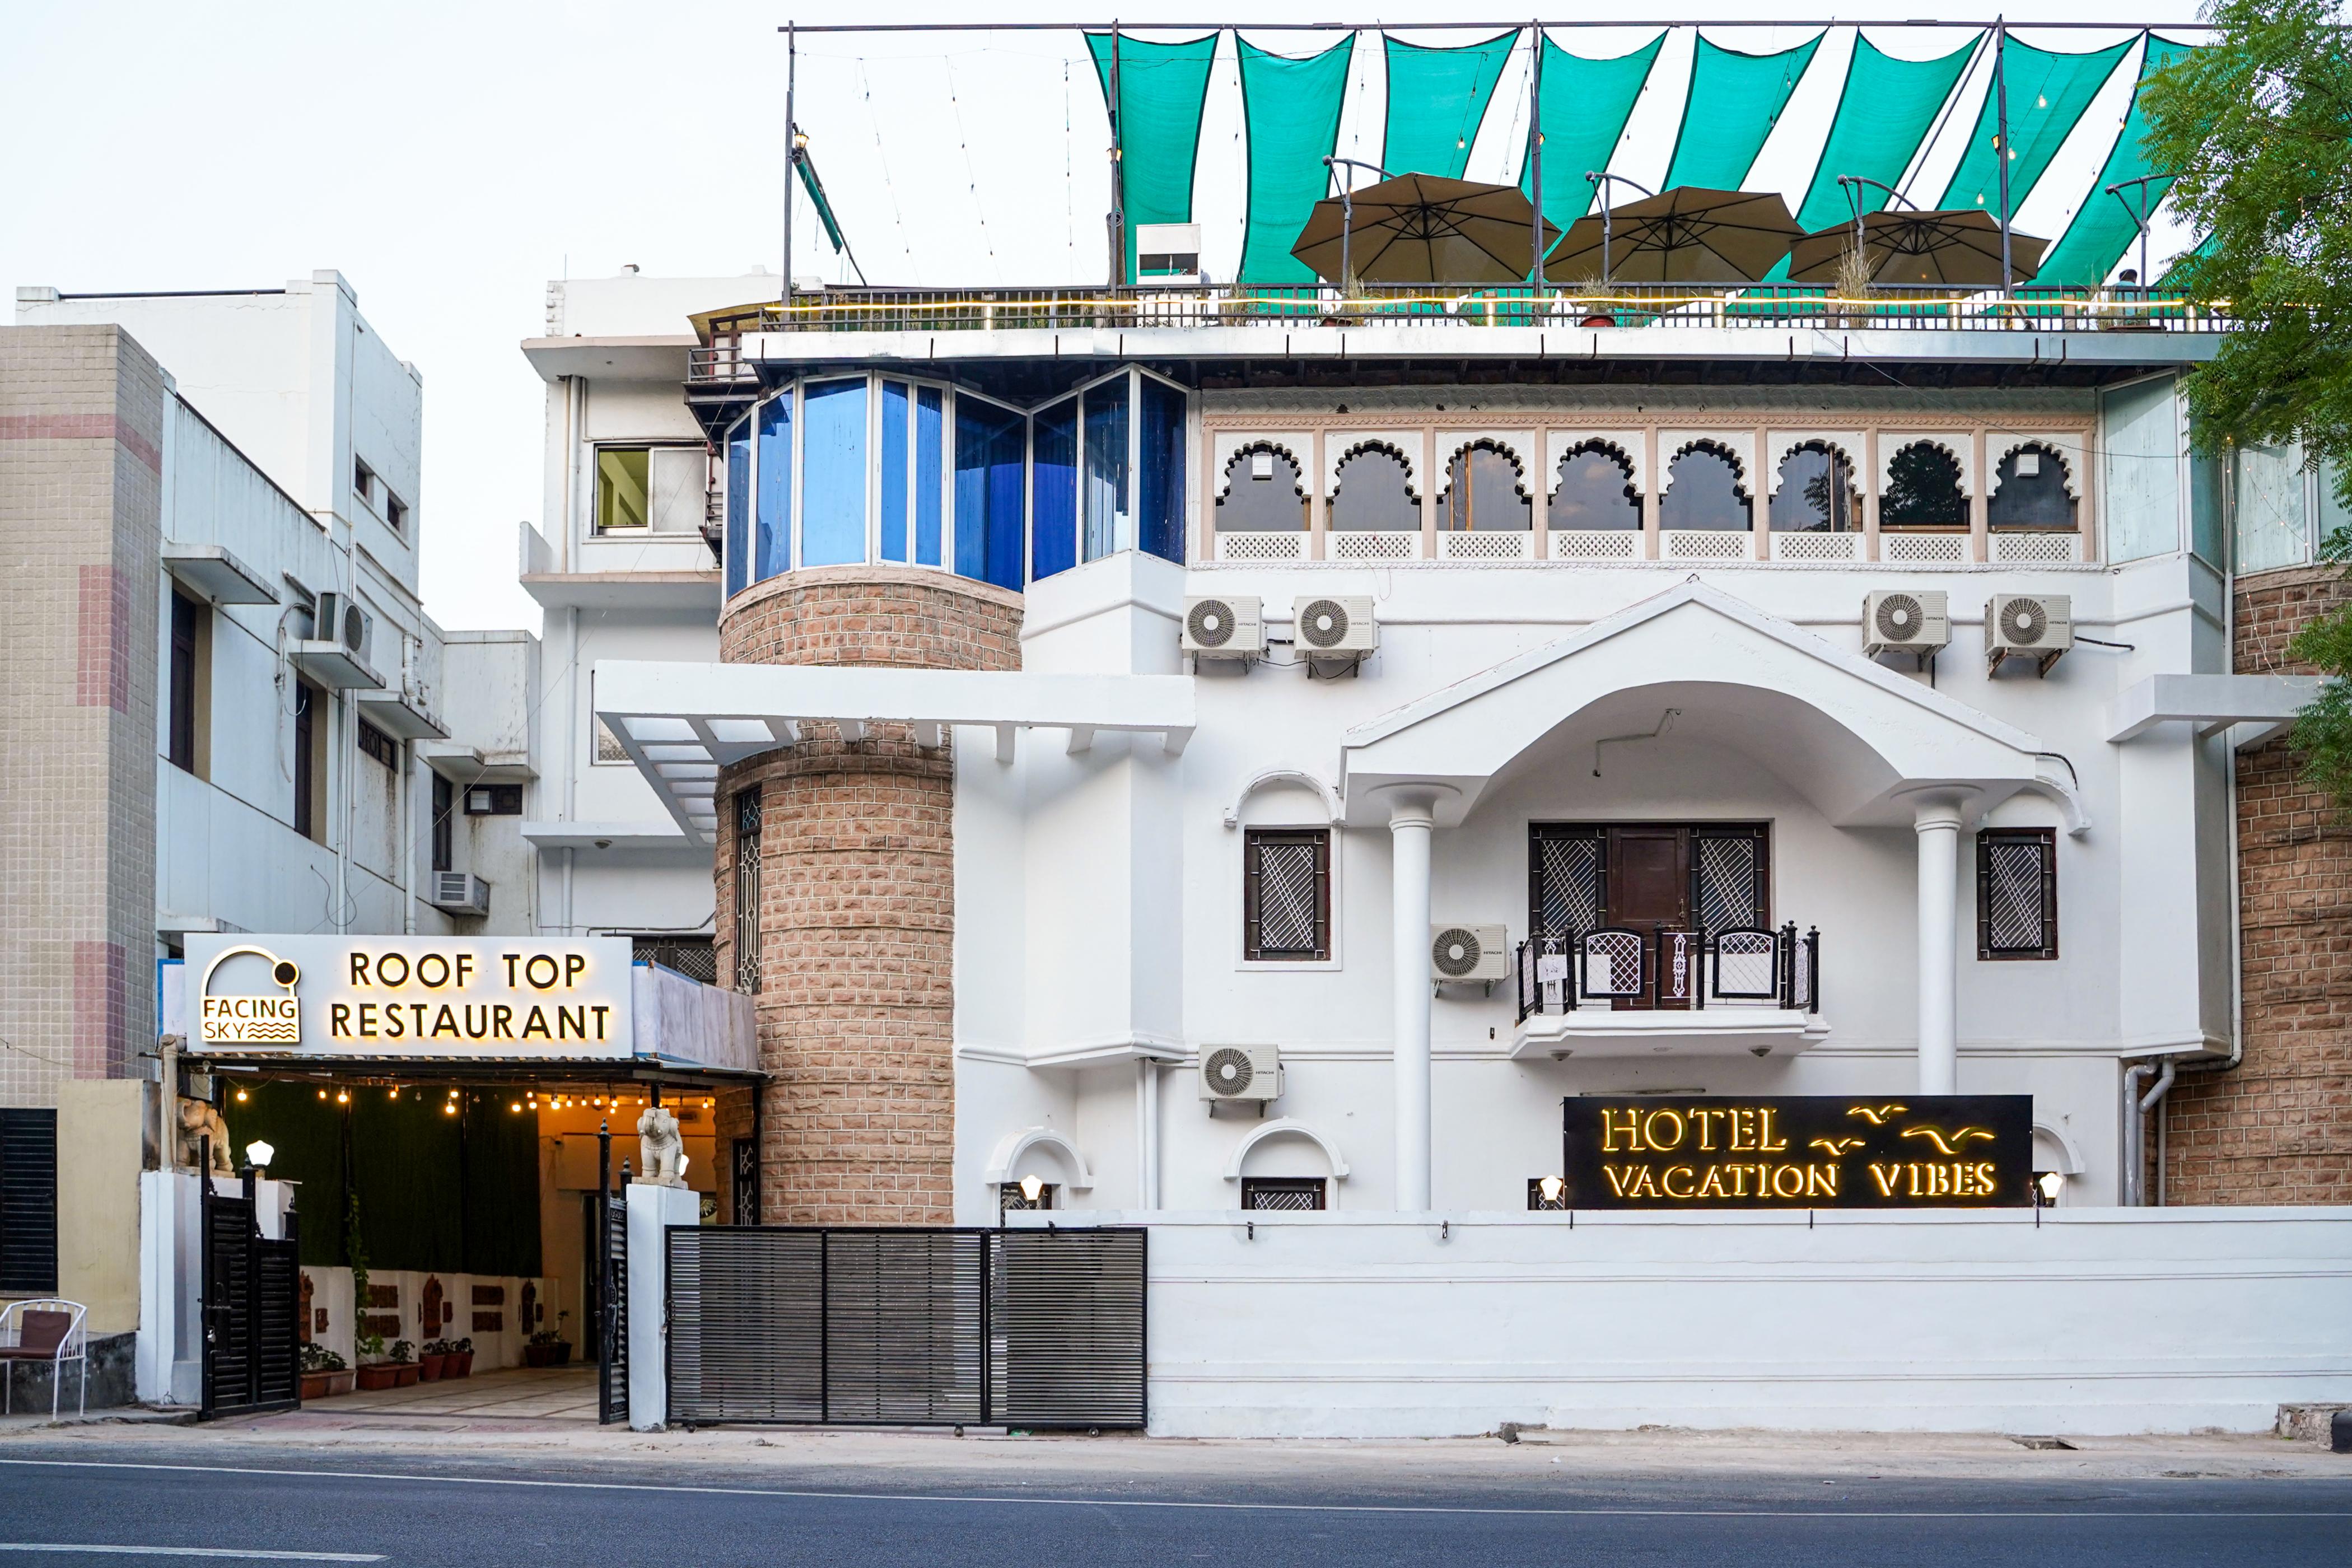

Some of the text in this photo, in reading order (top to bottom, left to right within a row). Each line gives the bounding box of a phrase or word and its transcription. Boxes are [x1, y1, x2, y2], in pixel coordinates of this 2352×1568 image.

[350, 953, 585, 989] ROOF TOP
[204, 1000, 295, 1018] FACING
[331, 1003, 609, 1040] RESTAURANT
[204, 1022, 245, 1039] SKY
[1602, 1108, 1788, 1151] HOTEL
[1603, 1162, 1998, 1197] VACATION VIBES
